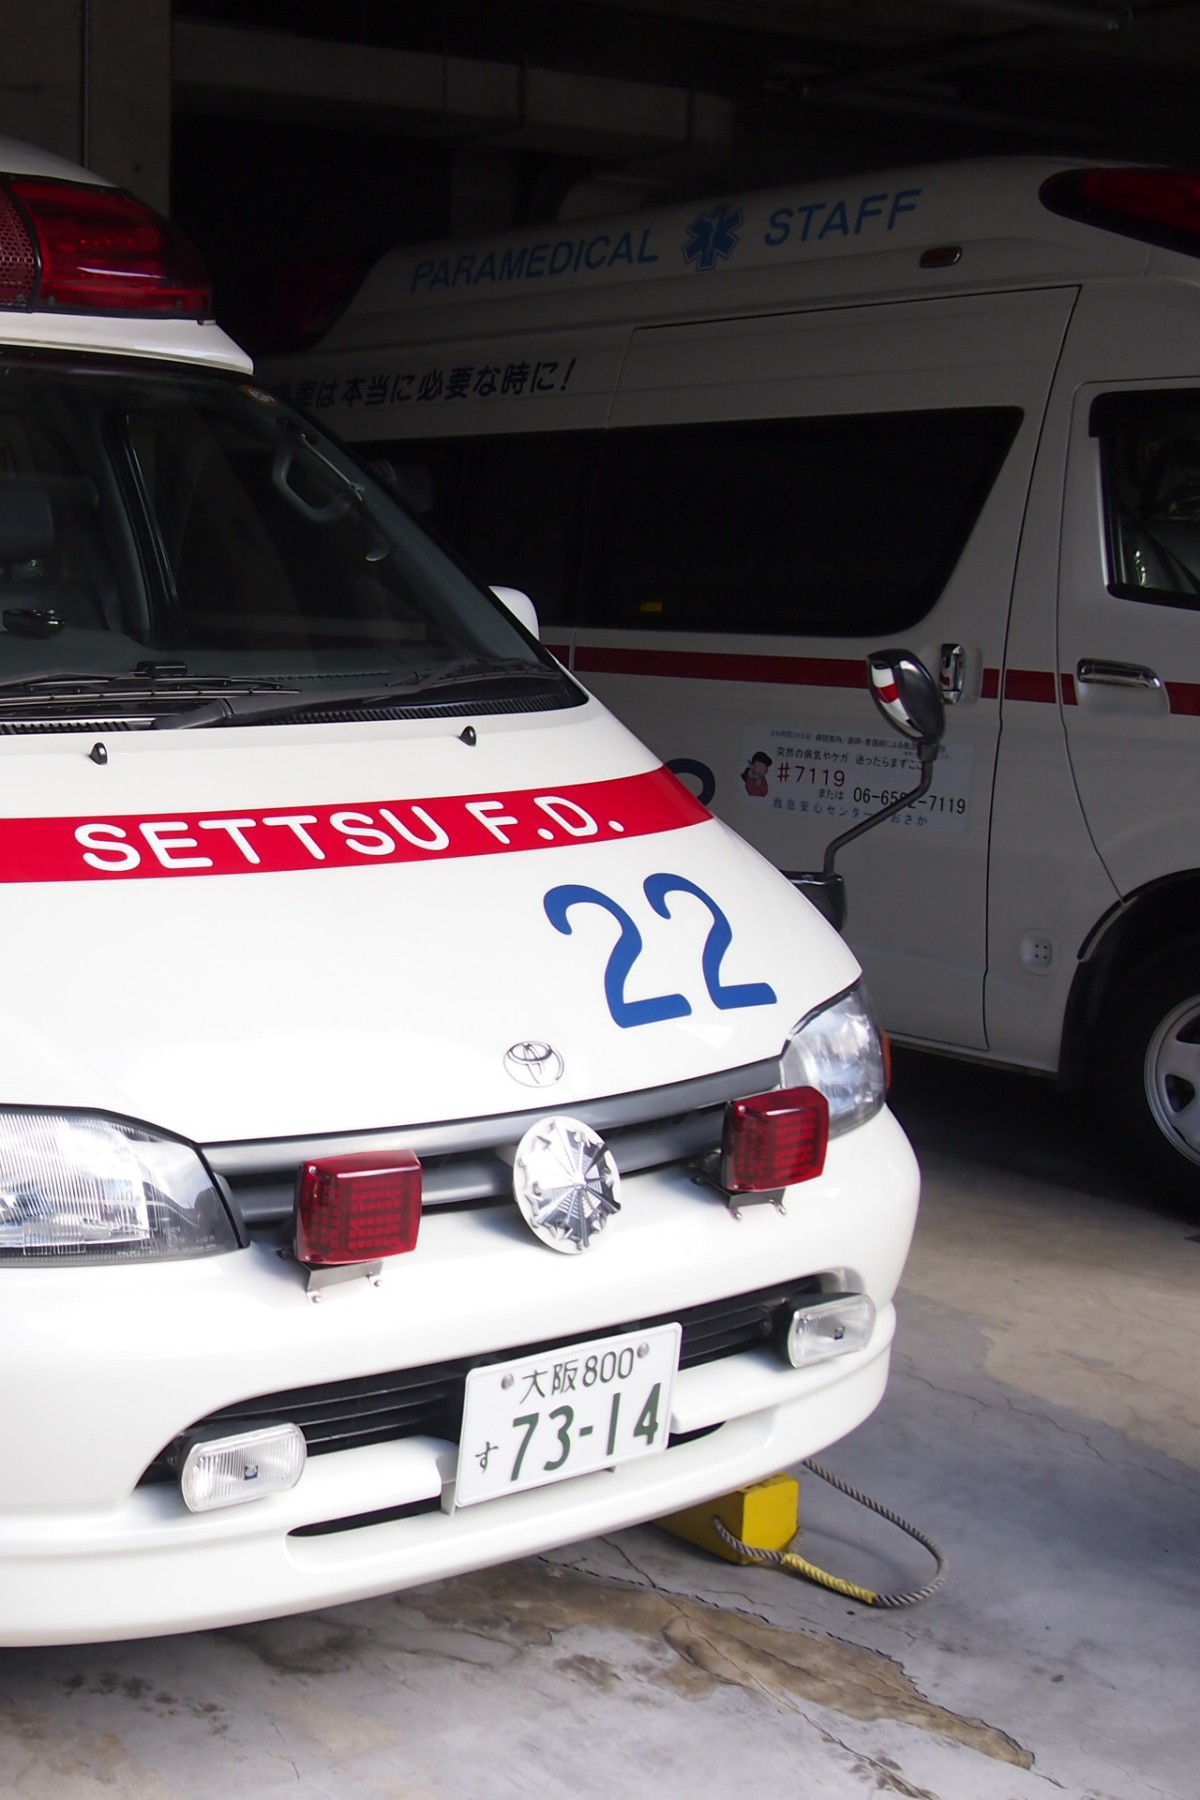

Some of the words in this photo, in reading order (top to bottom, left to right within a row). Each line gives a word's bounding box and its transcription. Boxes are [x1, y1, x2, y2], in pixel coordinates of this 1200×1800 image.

[410, 229, 659, 293] PARAMEDICAL
[764, 188, 923, 247] STAFF
[776, 746, 849, 764] 突然の病気やケガ
[777, 762, 846, 788] #7119
[773, 797, 928, 827] 救急安心センターおさか
[818, 788, 844, 801] または
[74, 805, 451, 872] SETTSU
[466, 795, 625, 845] F.D.
[543, 873, 777, 1028] 22
[474, 1441, 499, 1473] す
[510, 1382, 662, 1482] 73-14
